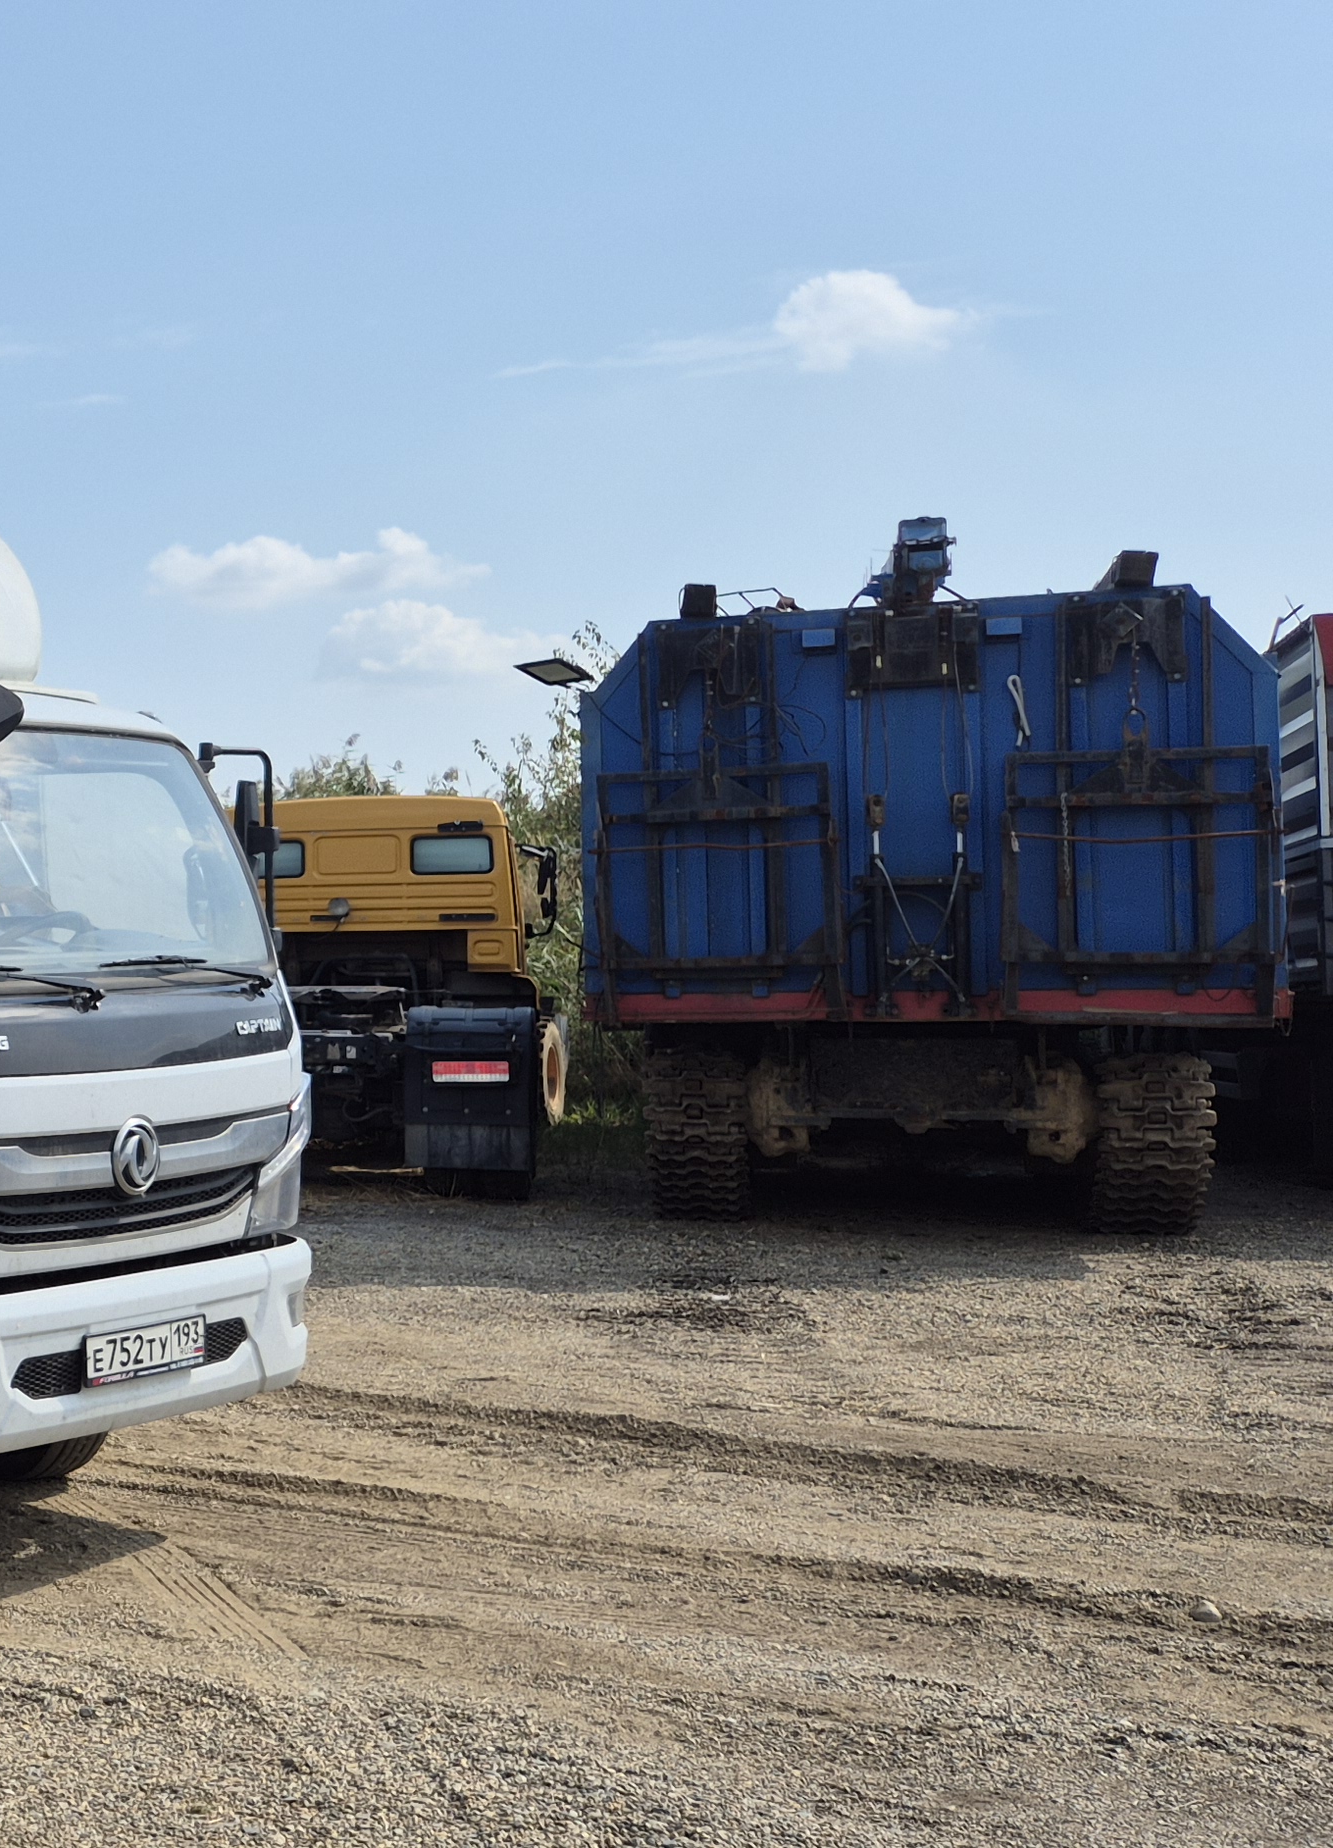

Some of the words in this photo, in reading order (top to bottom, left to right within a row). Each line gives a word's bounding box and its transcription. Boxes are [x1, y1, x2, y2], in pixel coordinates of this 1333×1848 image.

[236, 1018, 282, 1035] CAPTAIN
[173, 1320, 200, 1347] 193
[180, 1345, 193, 1355] RUS
